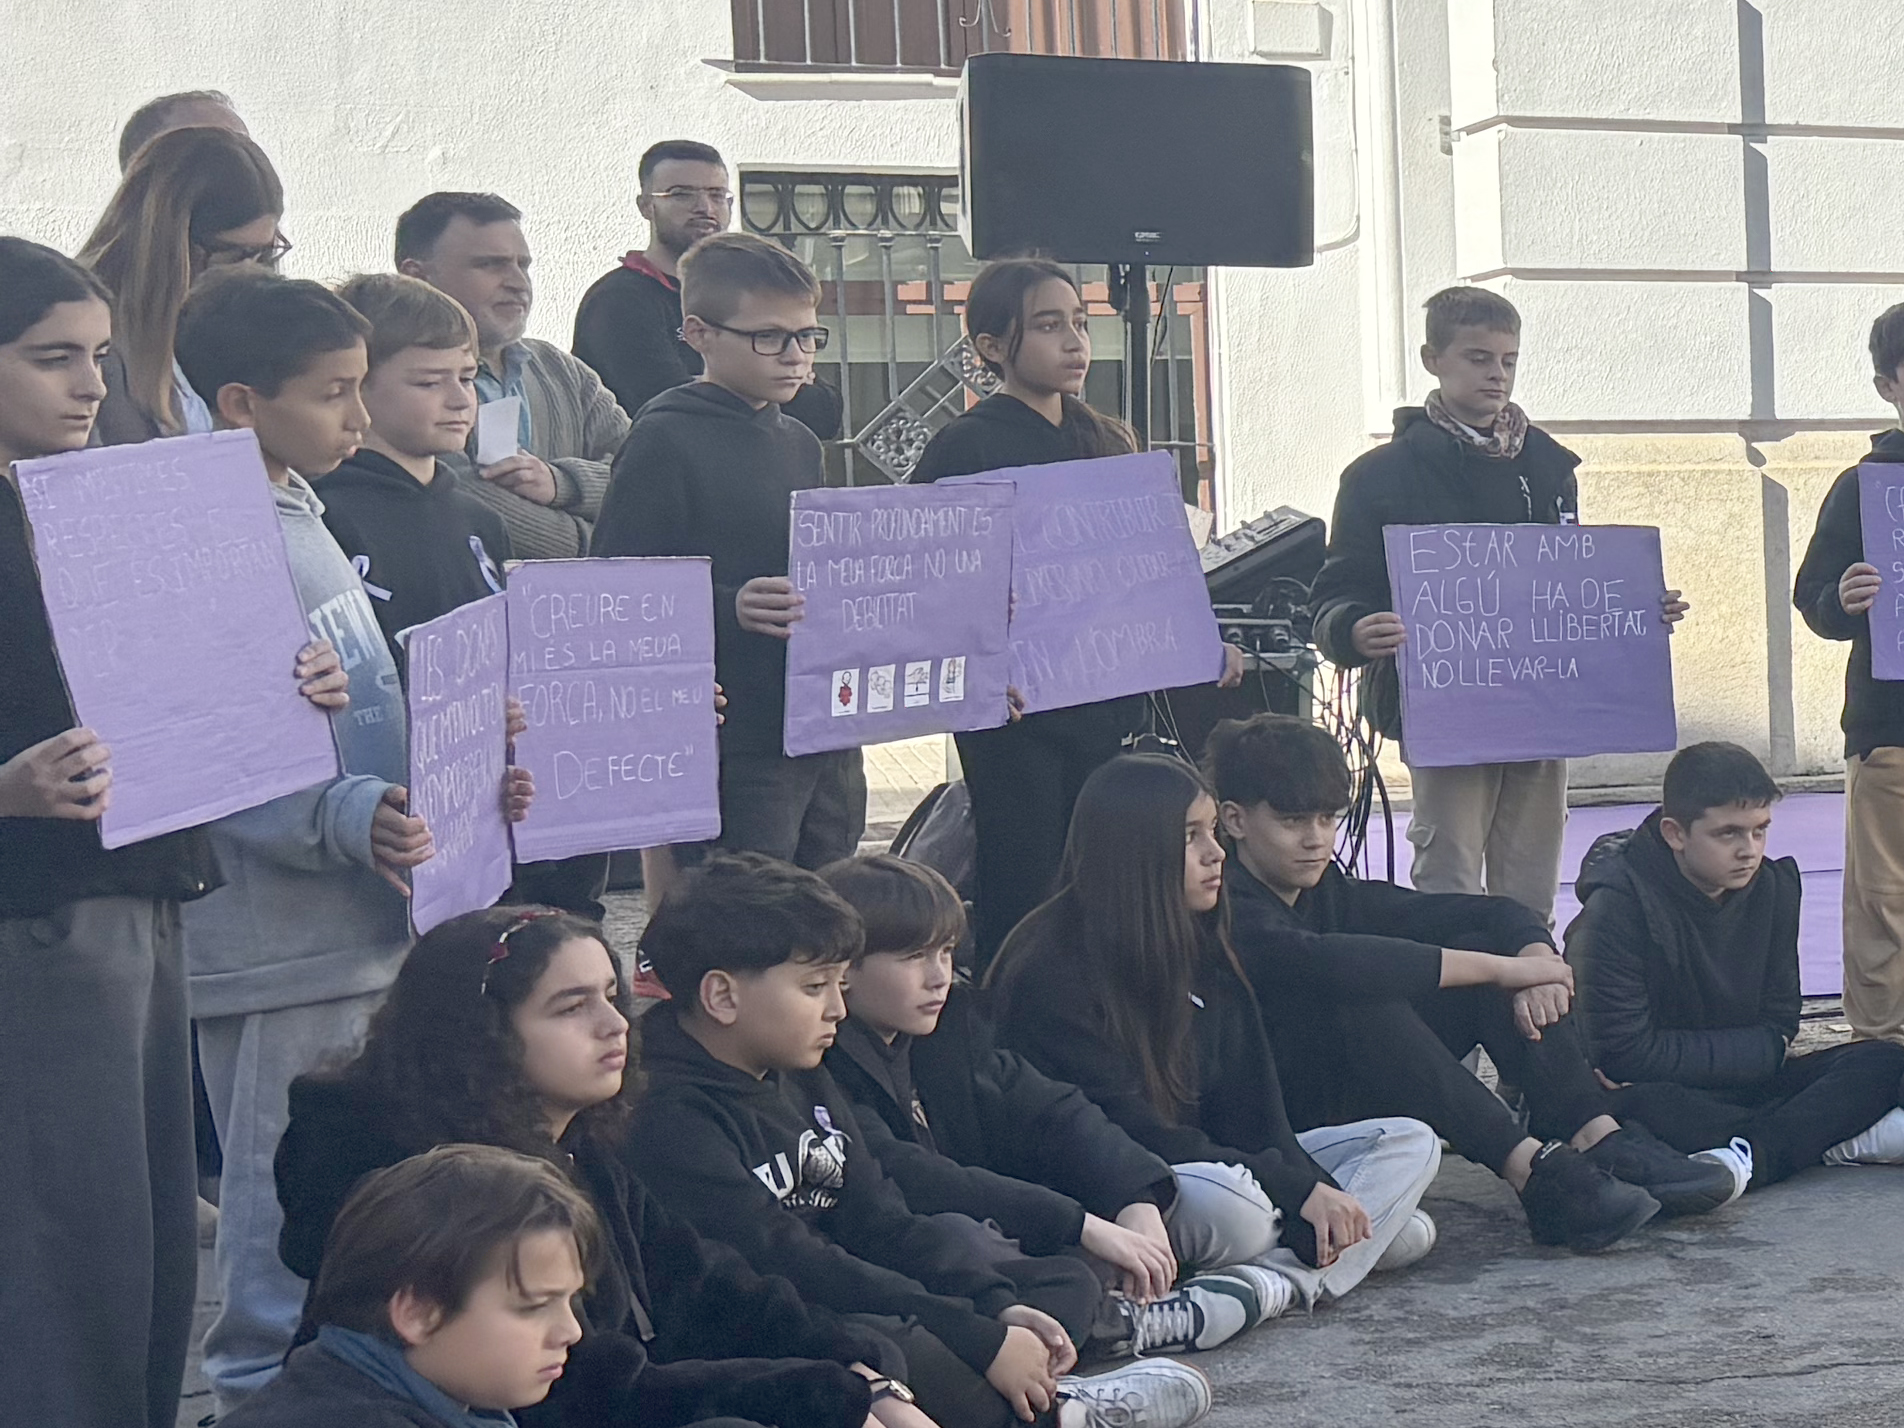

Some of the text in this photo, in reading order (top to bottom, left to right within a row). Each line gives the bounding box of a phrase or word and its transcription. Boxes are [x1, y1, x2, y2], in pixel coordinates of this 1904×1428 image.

[799, 508, 862, 547] SENTIR
[1537, 534, 1596, 563] AMB
[798, 558, 817, 591] LA
[924, 550, 946, 578] NO
[955, 548, 982, 574] UNA
[641, 594, 675, 621] EN
[1412, 570, 1625, 617] ALGÚ HA DE
[513, 634, 681, 673] MI ÉS LA MEUA
[1415, 617, 1514, 660] DONAR
[611, 685, 636, 719] NO
[641, 689, 663, 713] EL
[672, 686, 702, 705] MEU
